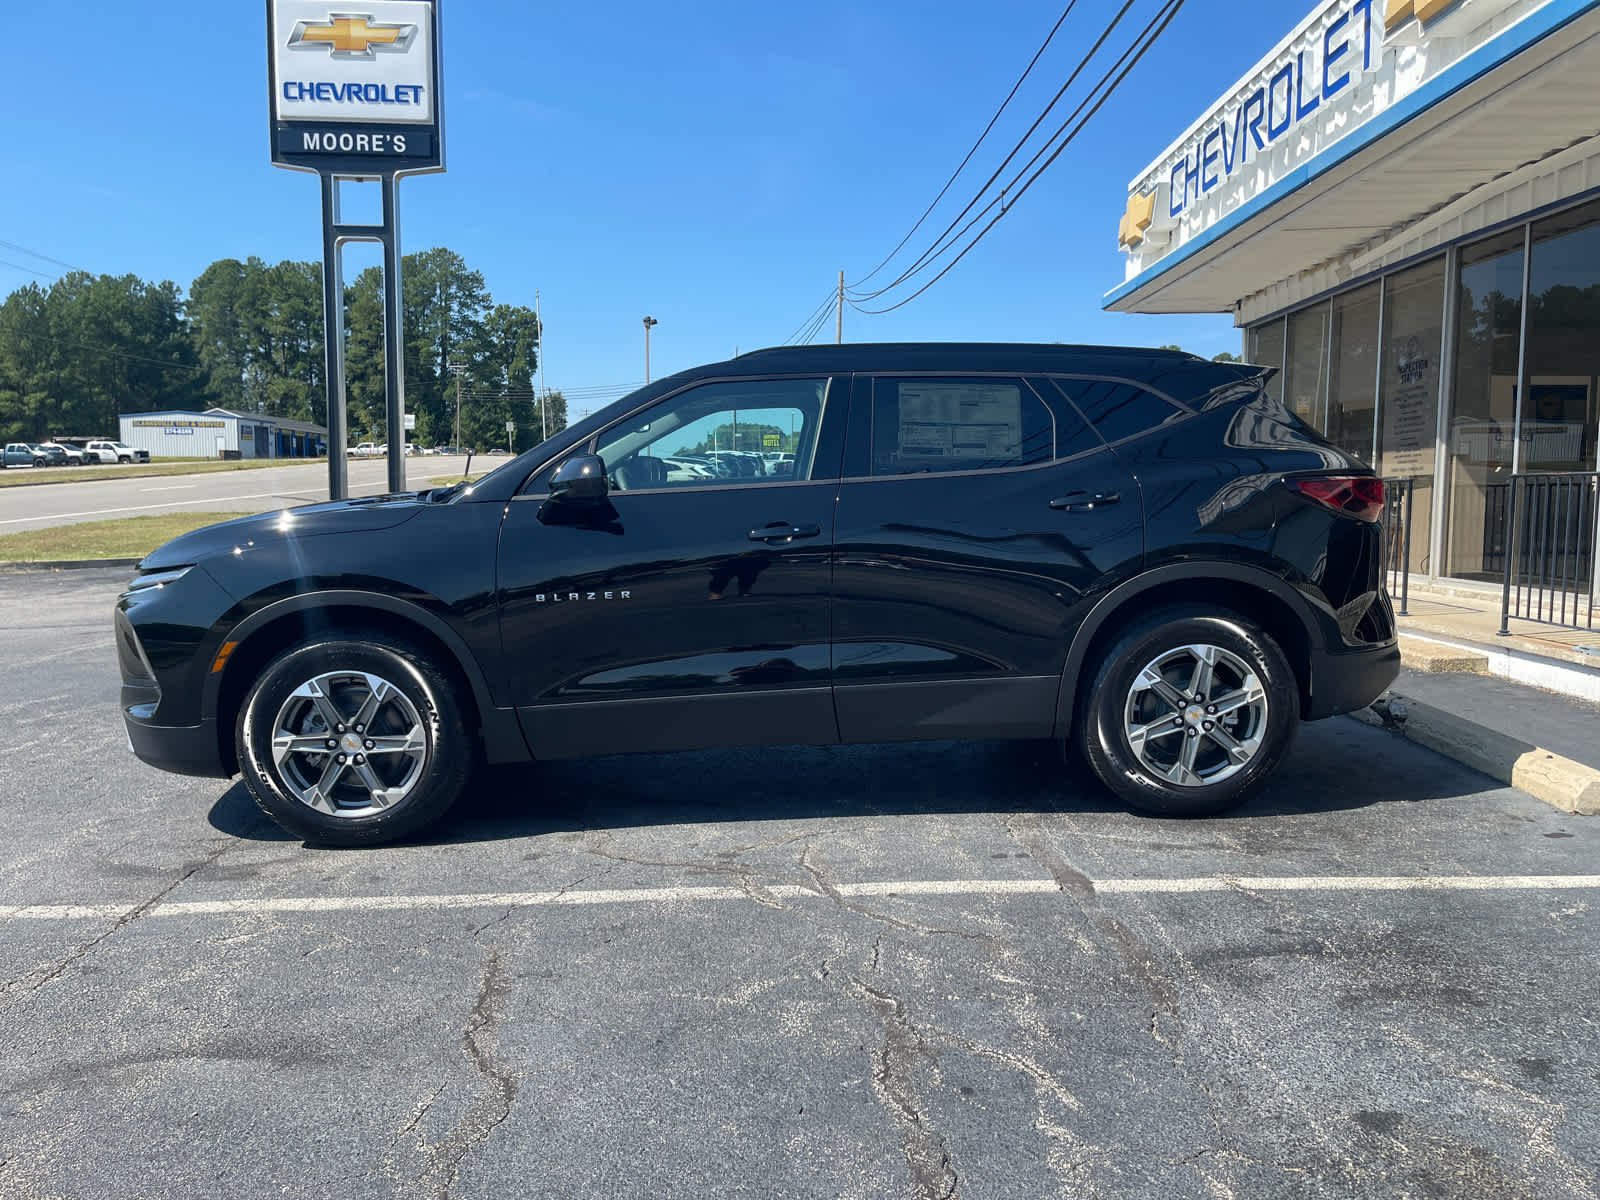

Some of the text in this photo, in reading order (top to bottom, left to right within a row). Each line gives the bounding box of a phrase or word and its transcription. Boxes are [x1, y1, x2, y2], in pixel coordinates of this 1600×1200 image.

[283, 81, 423, 104] CHEVROLET
[1169, 0, 1371, 217] CHEVROLET
[303, 132, 406, 153] MOORE'S
[535, 590, 631, 602] BLAZER
